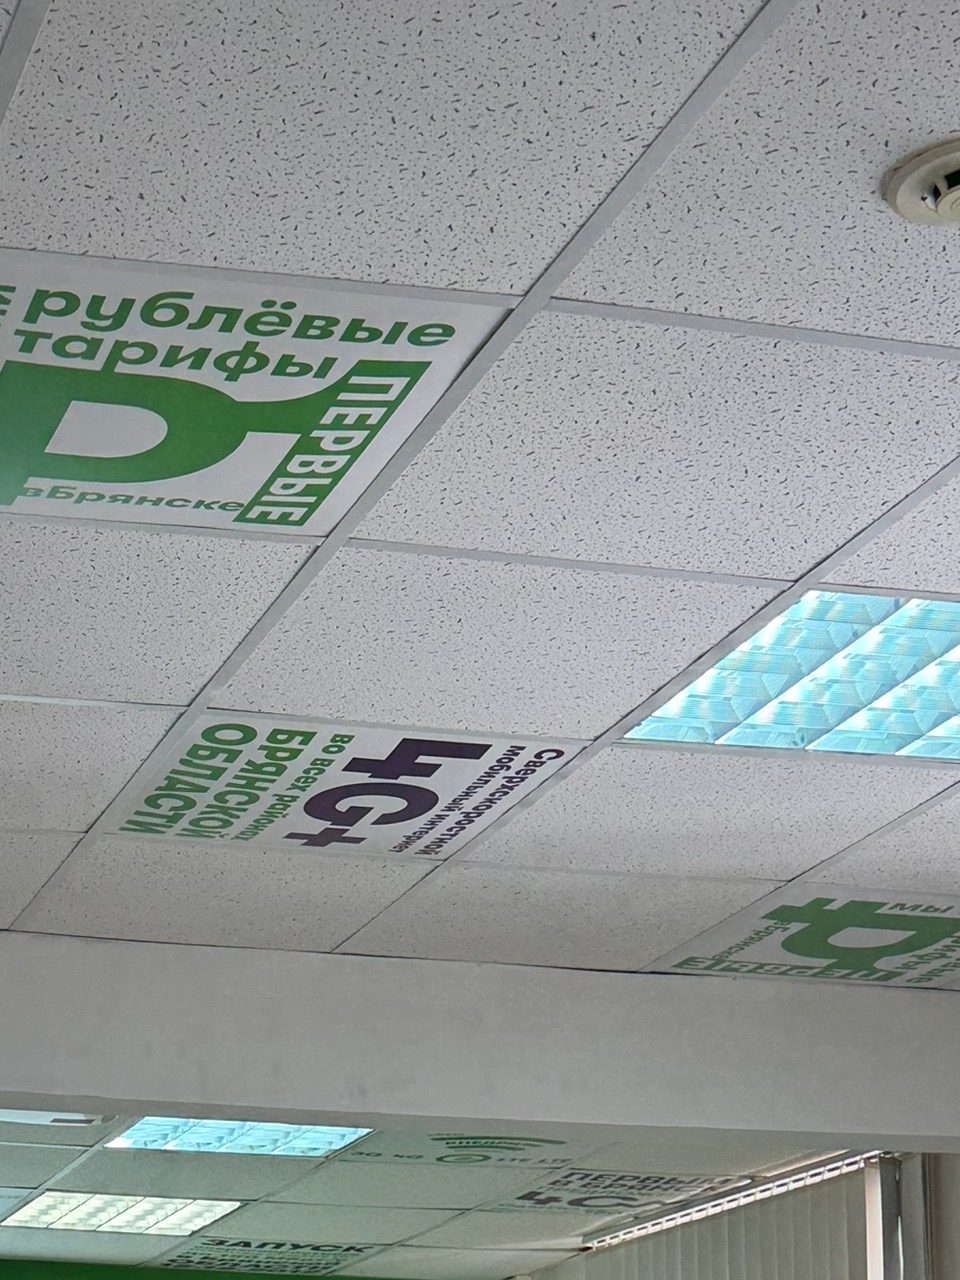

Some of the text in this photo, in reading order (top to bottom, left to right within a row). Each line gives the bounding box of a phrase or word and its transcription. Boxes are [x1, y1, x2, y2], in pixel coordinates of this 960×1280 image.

[13, 329, 338, 382] тарифы
[22, 289, 456, 346] рублёвые
[46, 485, 246, 512] Брянске
[245, 376, 411, 521] ПЕРВЫЕ
[118, 723, 258, 834] ОБЛАСТИ
[175, 728, 318, 839] БРЯНСКОЙ
[231, 733, 355, 841] во всех районах
[282, 738, 493, 848] 4G+
[388, 745, 526, 853] мобильный интернет
[415, 749, 565, 855] Сверхскоростной
[201, 1239, 374, 1253] ЗАПУСК
